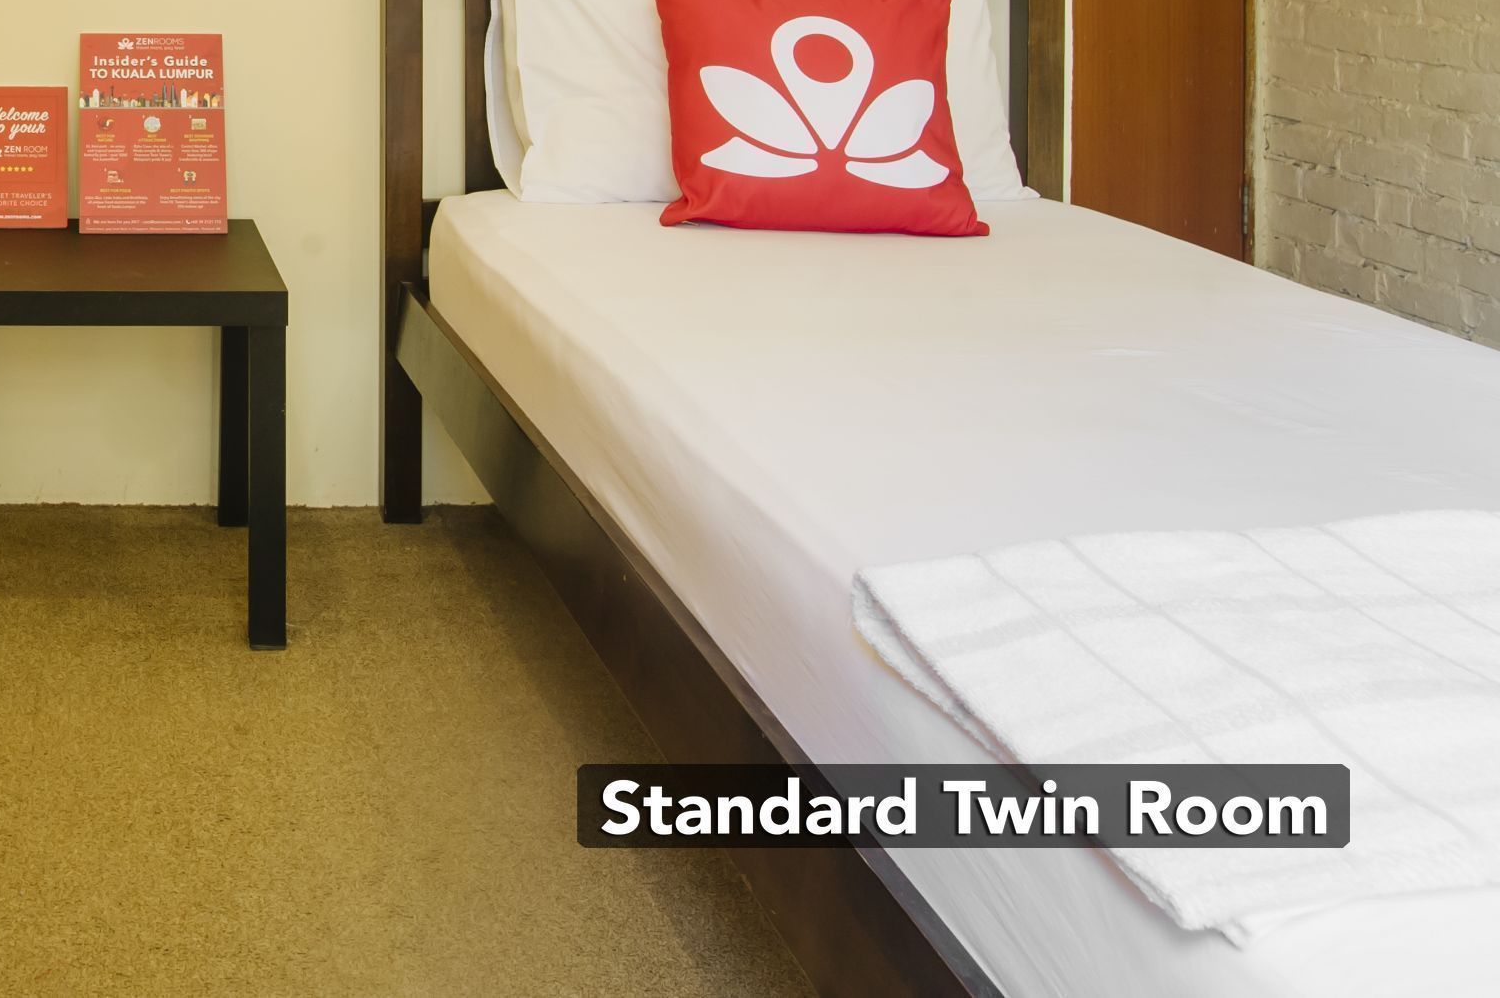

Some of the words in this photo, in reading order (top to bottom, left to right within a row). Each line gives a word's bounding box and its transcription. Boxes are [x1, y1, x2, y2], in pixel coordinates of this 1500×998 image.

[93, 55, 158, 67] Insider's
[163, 55, 208, 67] Guide
[89, 68, 108, 79] TO
[111, 68, 156, 79] KUALA
[159, 68, 214, 79] LUMPUR
[8, 123, 47, 141] your
[3, 145, 22, 153] ZEN
[23, 145, 48, 153] ROOM
[11, 192, 52, 200] TRAVELER'S
[20, 199, 48, 207] CHOICE
